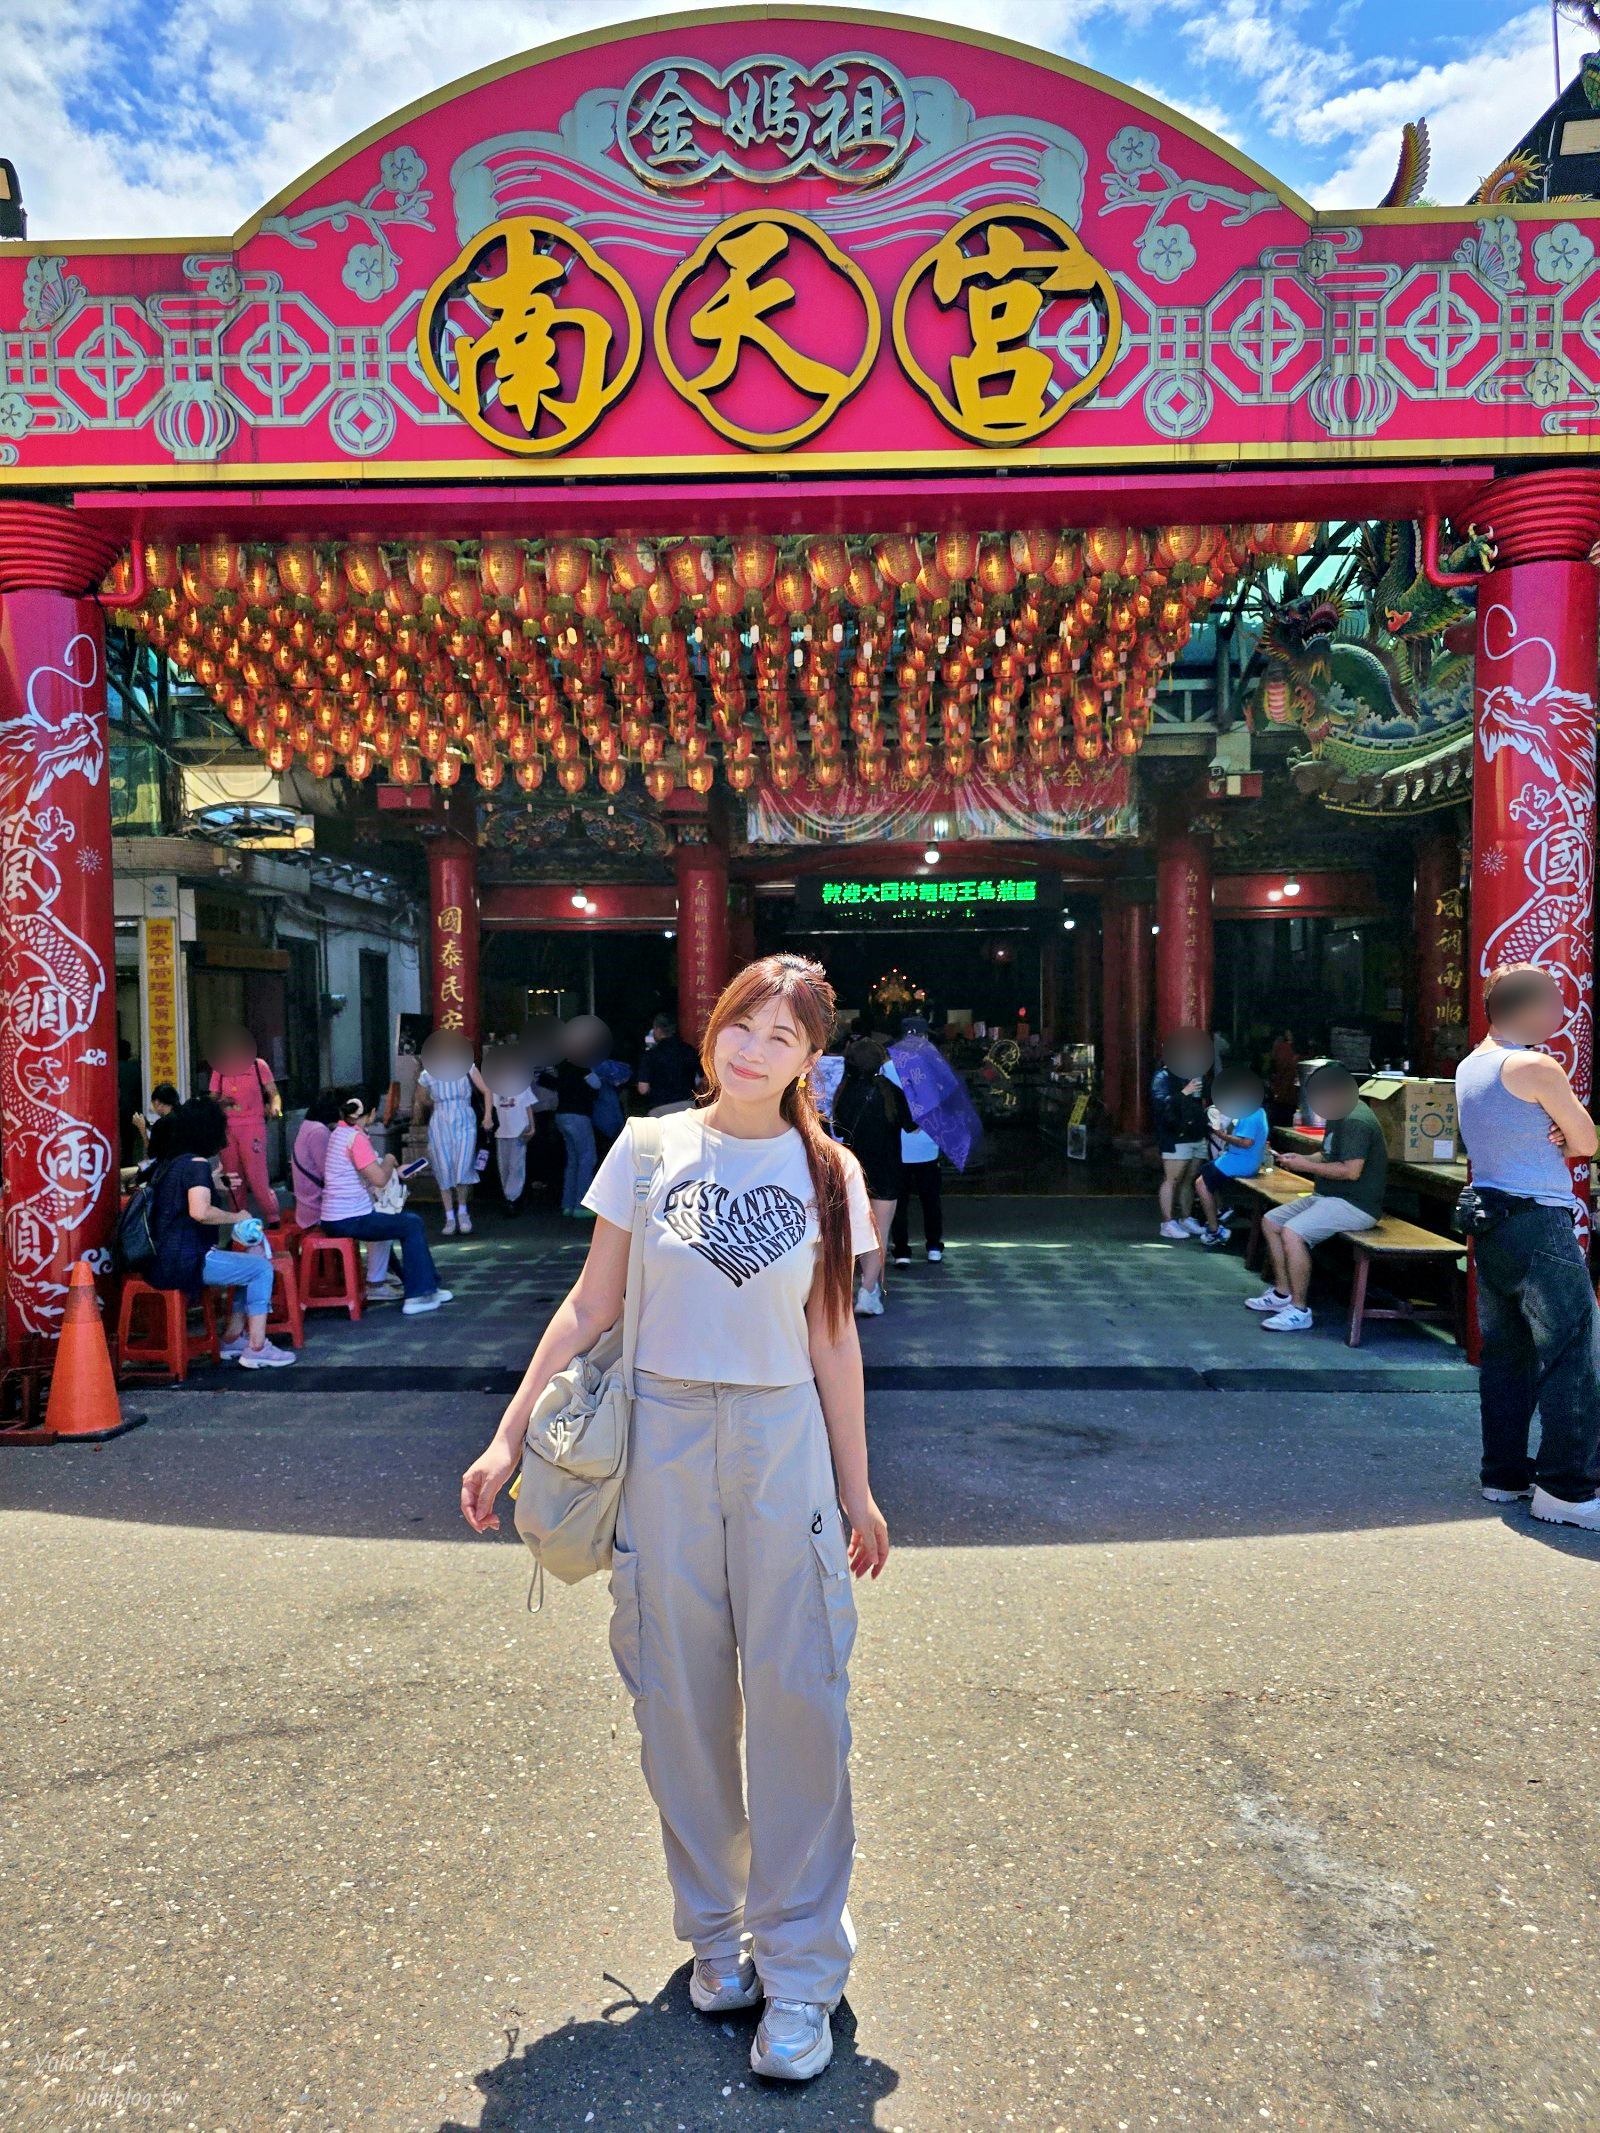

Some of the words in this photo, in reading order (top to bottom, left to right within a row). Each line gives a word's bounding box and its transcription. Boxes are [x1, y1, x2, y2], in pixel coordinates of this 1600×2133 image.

[628, 69, 899, 167] 金媽祖
[454, 221, 1101, 432] 南天宮
[437, 906, 464, 1031] 國泰民安
[663, 1180, 806, 1225] BOSTANTEN
[664, 1209, 806, 1245] BOSTANTEN
[688, 1225, 806, 1288] BOSTANTEN
